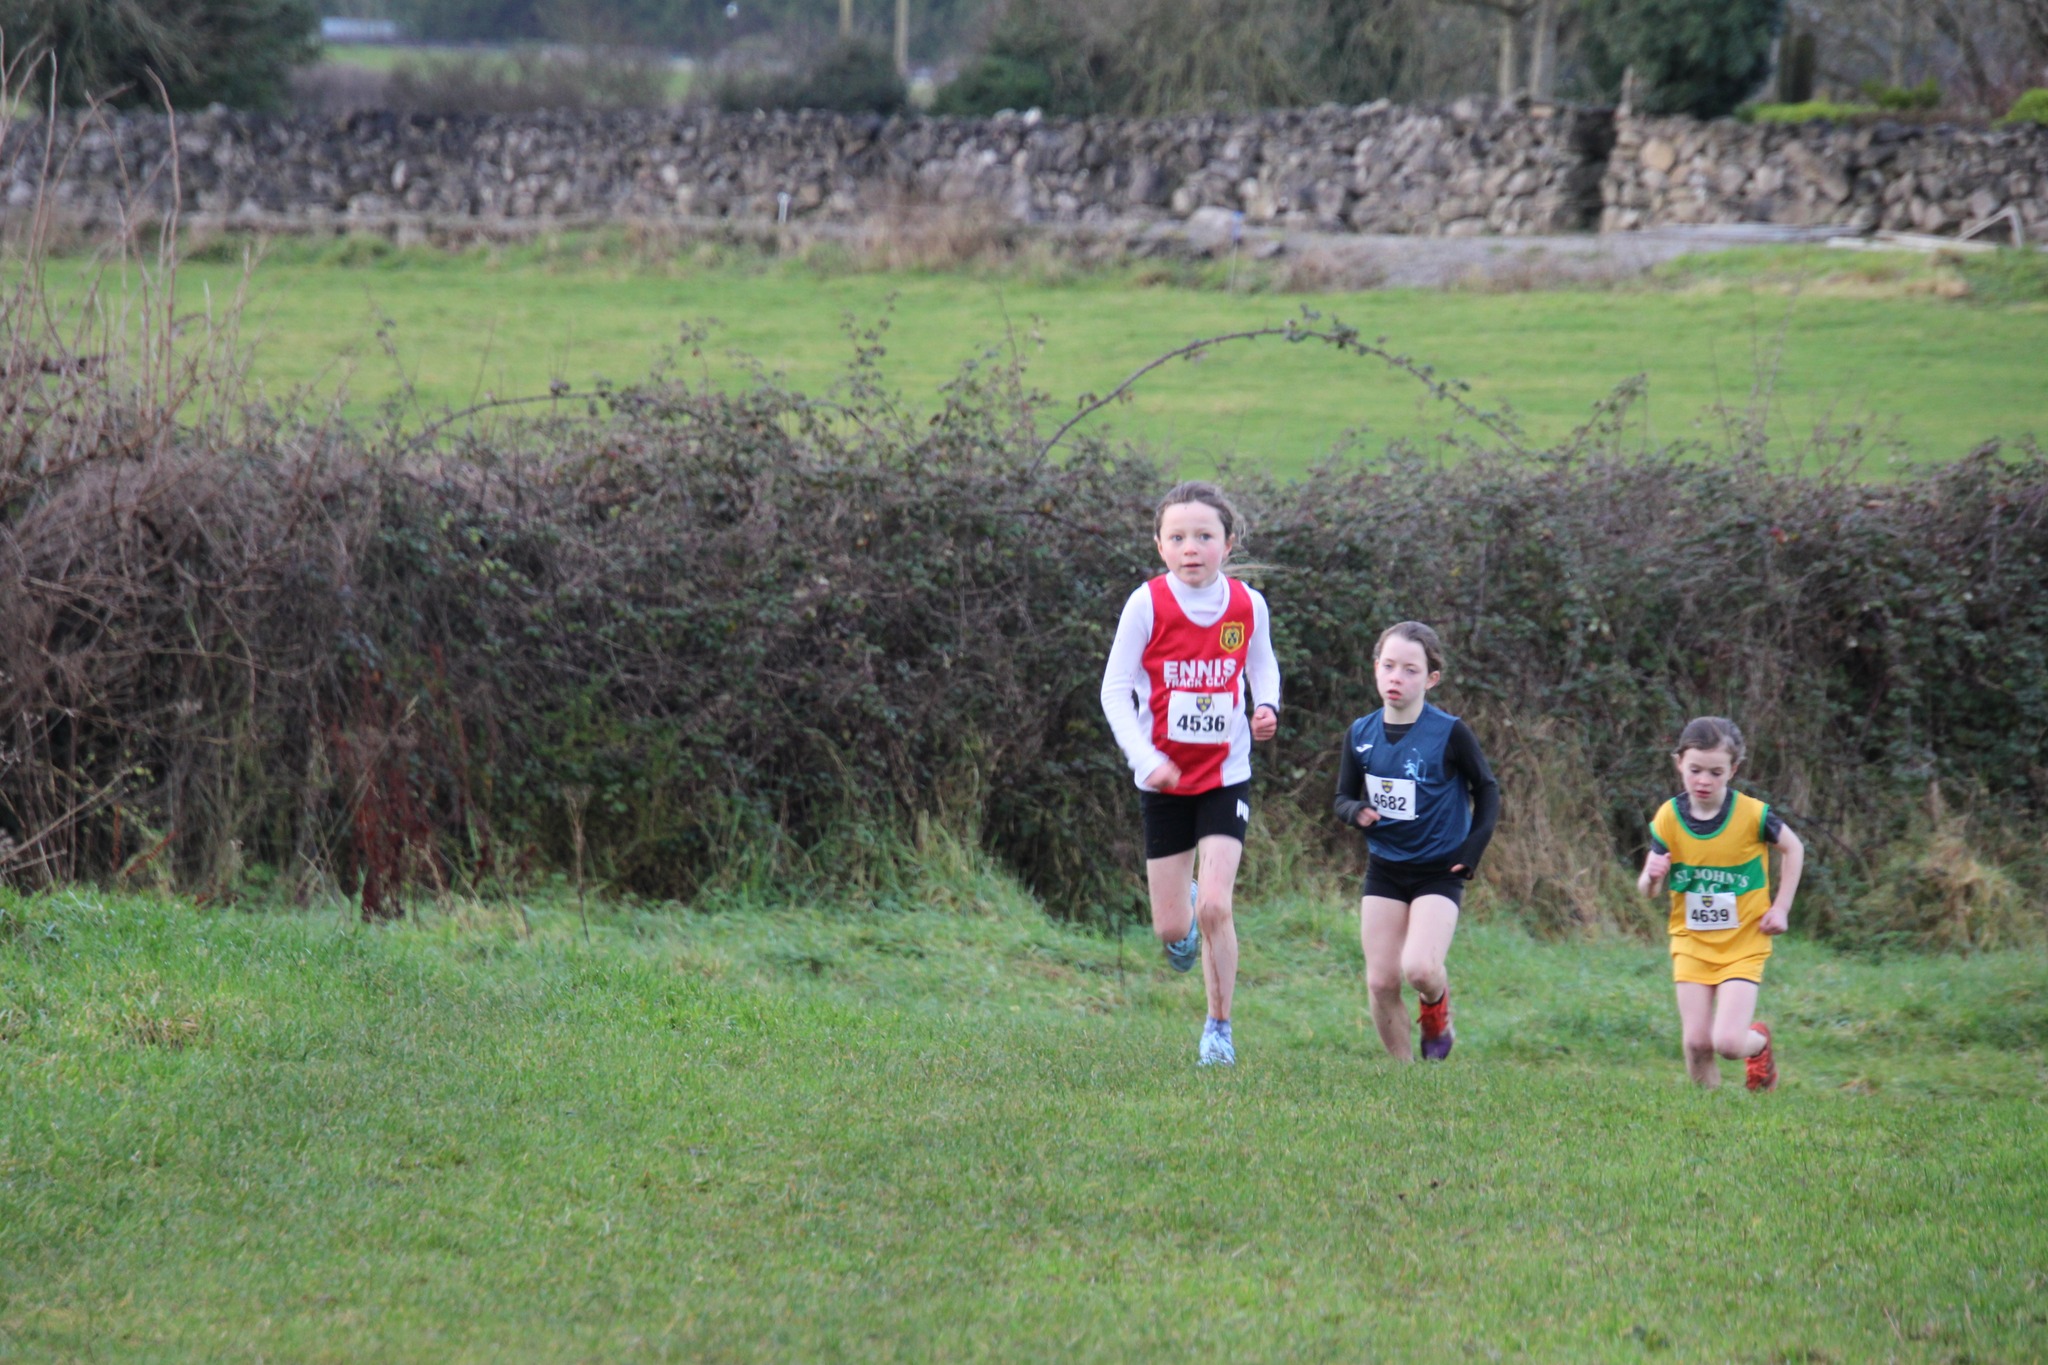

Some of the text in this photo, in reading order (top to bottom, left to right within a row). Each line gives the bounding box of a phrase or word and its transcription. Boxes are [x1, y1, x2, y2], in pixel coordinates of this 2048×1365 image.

[1163, 658, 1237, 679] ENNIS
[1177, 714, 1225, 732] 4536
[1373, 793, 1406, 811] 4682
[1691, 908, 1729, 923] 4639
